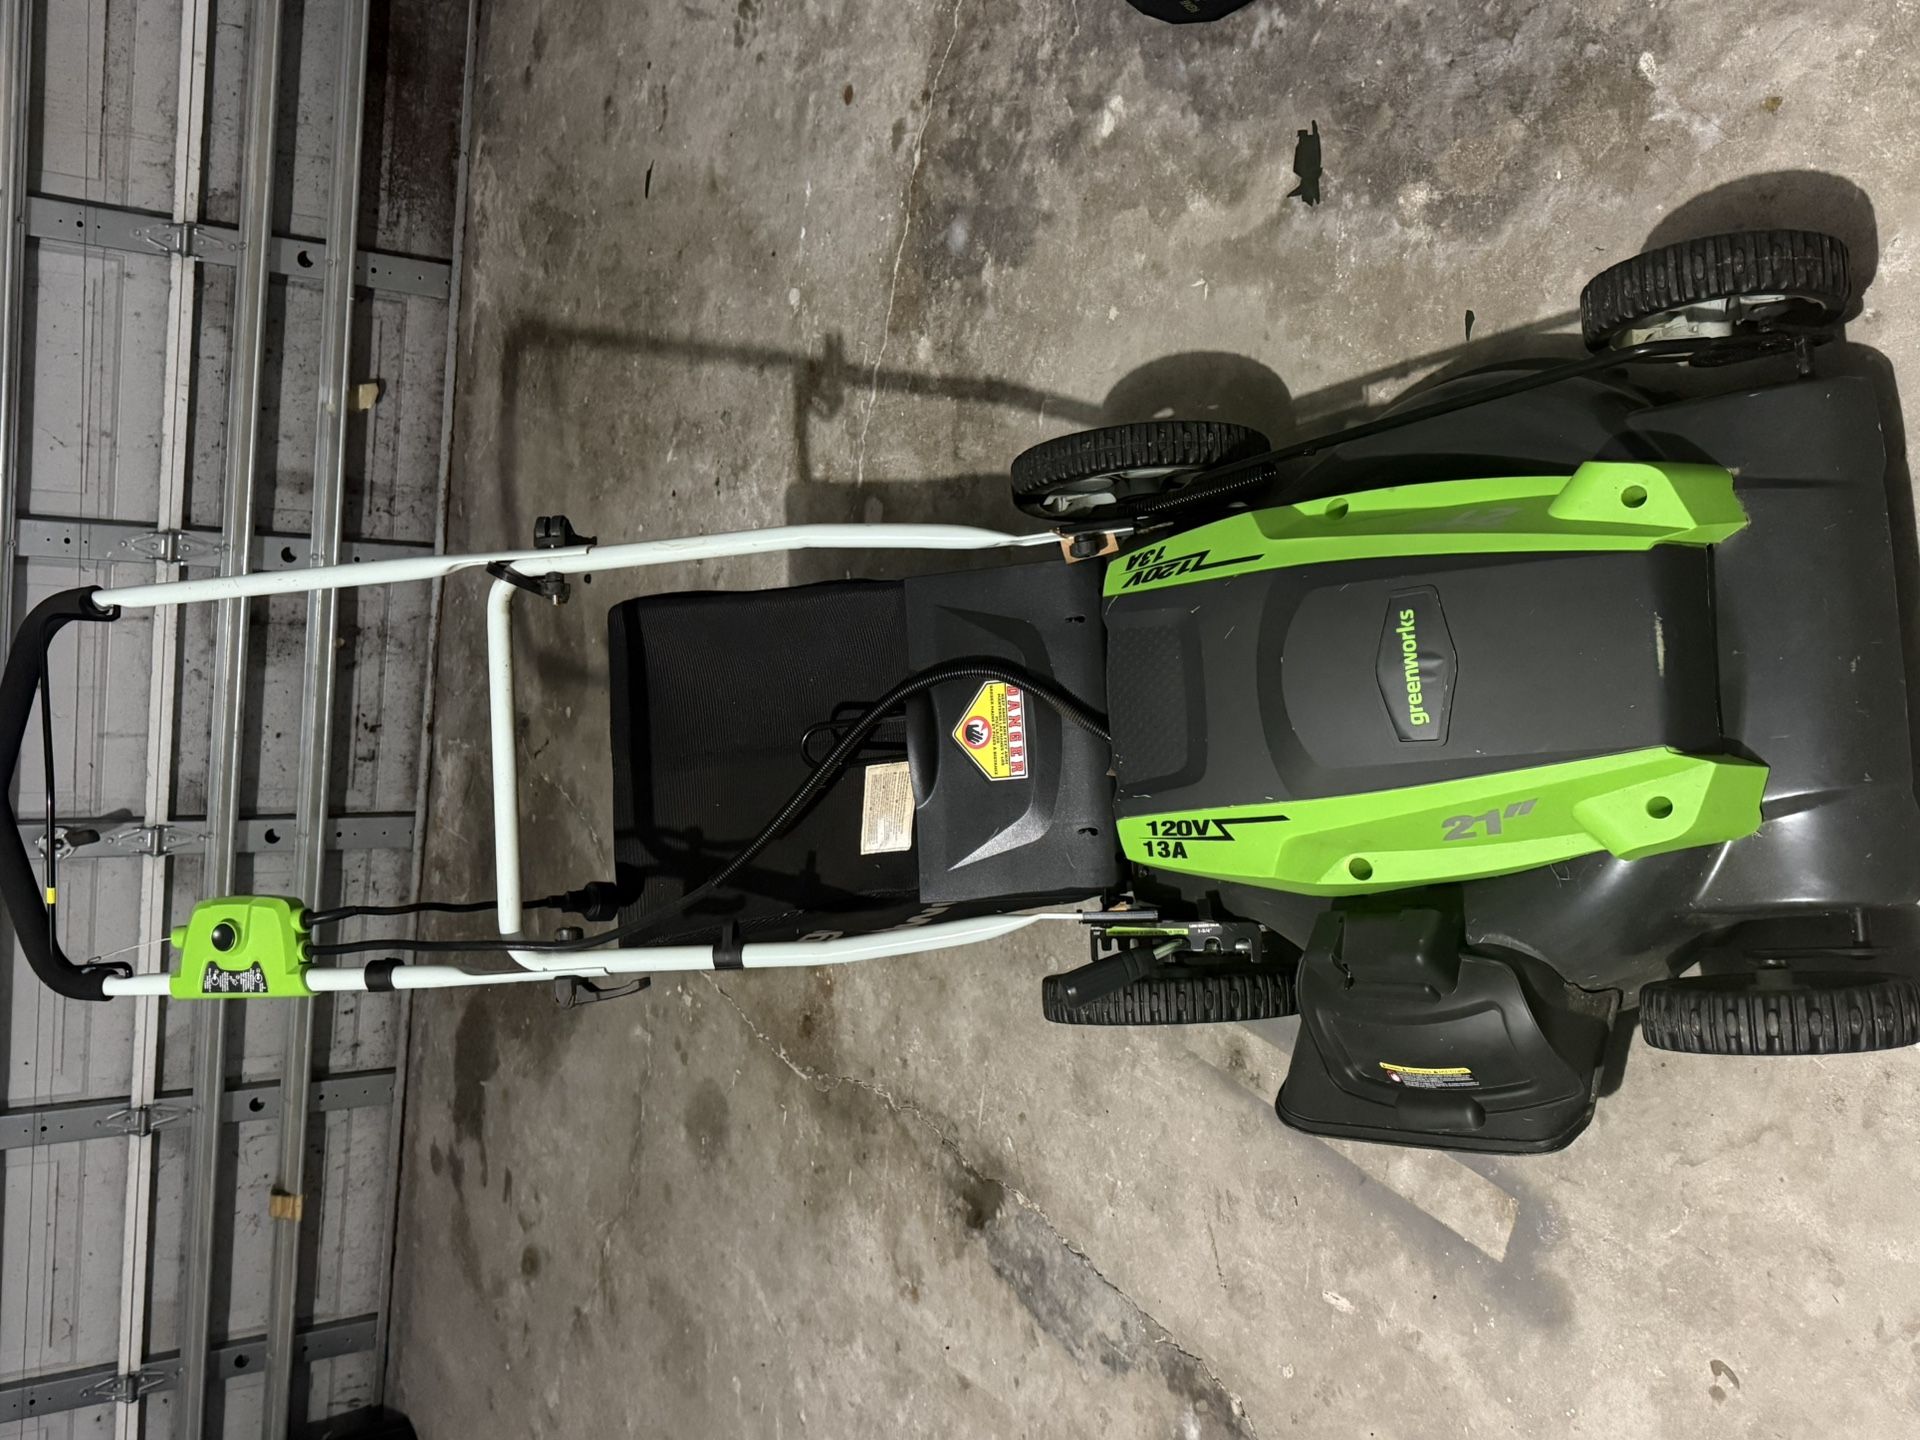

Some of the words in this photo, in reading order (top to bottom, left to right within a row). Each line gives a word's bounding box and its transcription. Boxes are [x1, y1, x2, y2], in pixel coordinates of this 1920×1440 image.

[1126, 546, 1166, 571] 13A
[1122, 559, 1193, 589] 120V
[1396, 608, 1430, 725] greenworks
[1006, 686, 1024, 773] DANGER
[1146, 819, 1210, 837] 120V
[1442, 798, 1538, 841] 21"
[1143, 840, 1188, 859] 13A
